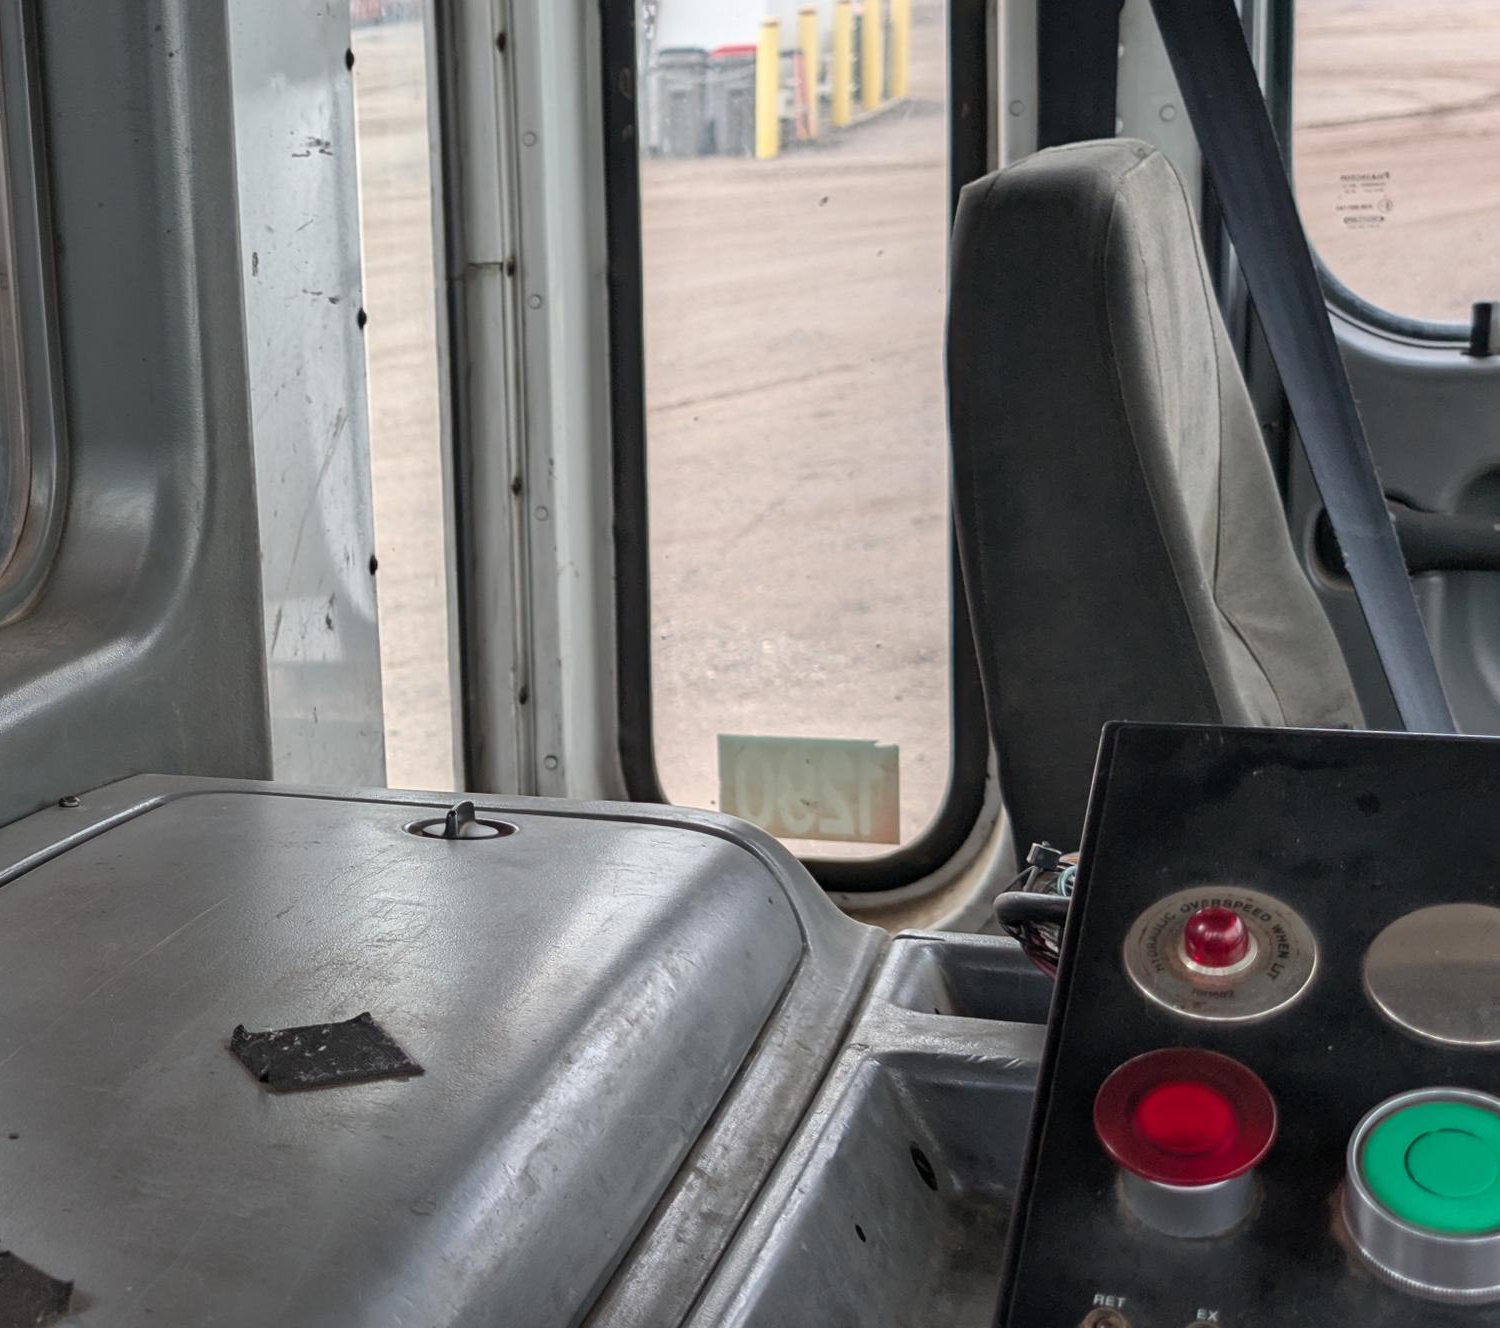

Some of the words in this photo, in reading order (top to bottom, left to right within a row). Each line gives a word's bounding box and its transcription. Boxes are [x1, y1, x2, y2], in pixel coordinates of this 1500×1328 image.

[1180, 898, 1272, 923] OVERSPEED
[1146, 911, 1177, 975] HYDRAULIC
[1271, 924, 1290, 963] WHEN
[1266, 962, 1285, 981] LIT
[1092, 1293, 1126, 1308] RET
[1196, 1308, 1219, 1322] EX
